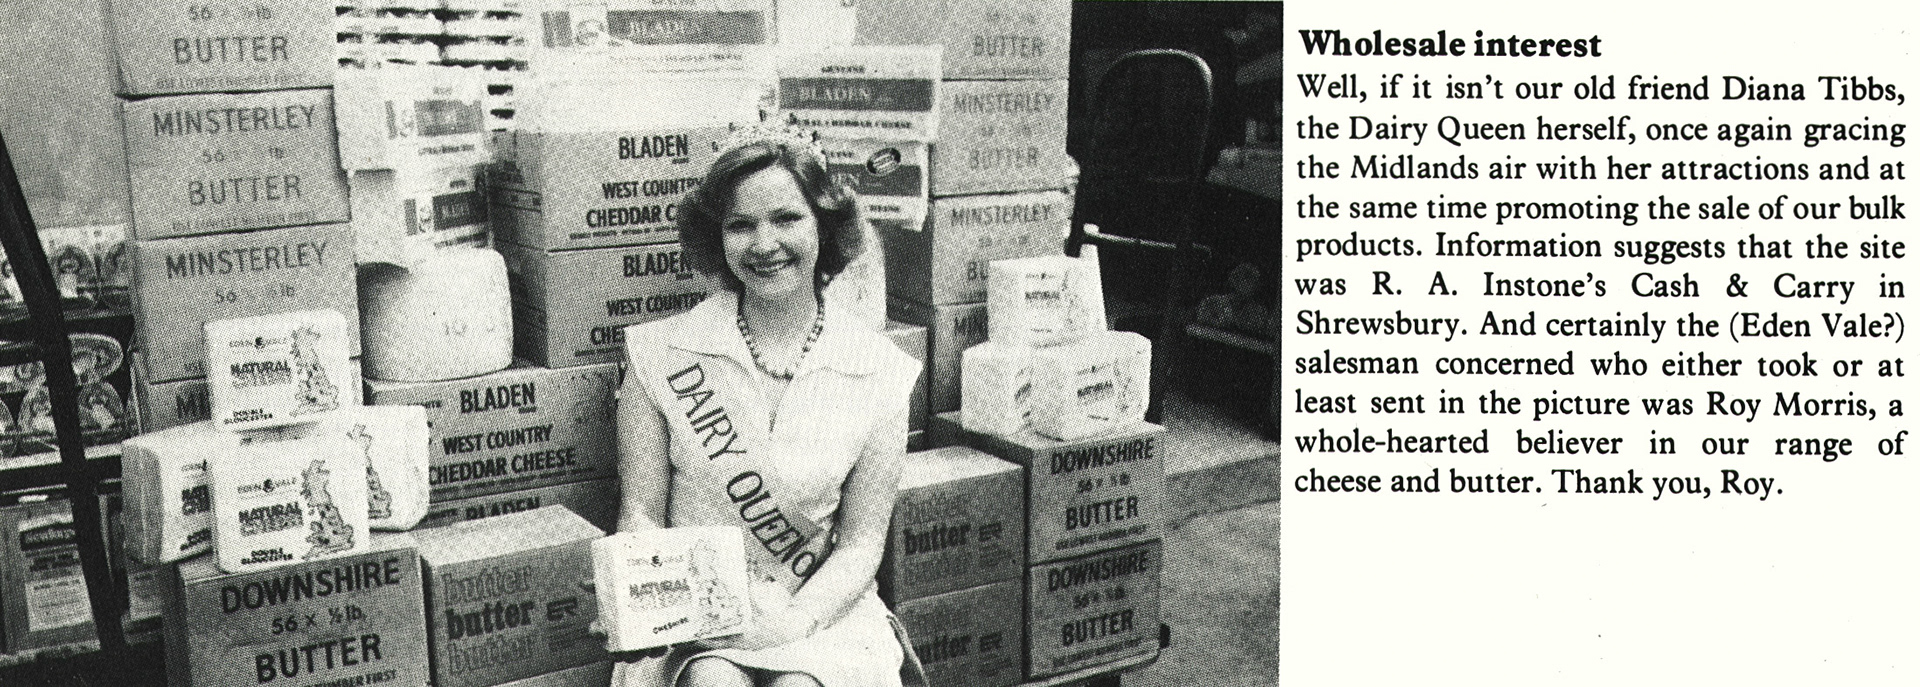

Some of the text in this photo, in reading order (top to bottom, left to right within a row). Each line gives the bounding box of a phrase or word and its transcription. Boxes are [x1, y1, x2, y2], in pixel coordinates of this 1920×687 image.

[174, 36, 289, 64] BUTTER
[973, 35, 1045, 58] BUTTER
[1299, 30, 1601, 57] Wholesale interest
[799, 87, 872, 102] BLADEN
[954, 92, 1054, 114] MINSTERLEY
[1297, 74, 1366, 103] Well,
[1381, 74, 1403, 98] if
[1413, 74, 1431, 98] it
[1516, 83, 1563, 99] our
[1574, 75, 1615, 100] old
[1628, 75, 1709, 100] friend
[1723, 76, 1805, 100] Diana
[1818, 76, 1904, 105] Tibbs,
[153, 105, 315, 136] MINSTERLEY
[1297, 115, 1906, 147] the Dairy Queen herself, once again gracing
[619, 134, 689, 160] BLADEN
[1297, 155, 1905, 180] the Midlands air with her attractions and at
[189, 175, 301, 206] BUTTER
[602, 181, 639, 200] WEST
[586, 204, 662, 228] CHEDDAR
[952, 203, 1051, 227] MINSTERLEY
[1297, 194, 1905, 226] the same time promoting the sale of our bulk
[166, 241, 327, 279] MINSTERLEY
[1297, 232, 1905, 264] products. Information suggests that the site
[1295, 278, 1346, 295] was
[1373, 272, 1401, 295] R.
[1429, 271, 1457, 295] A.
[1632, 273, 1699, 297] Cash
[1727, 274, 1748, 297] &
[1774, 273, 1854, 304] Carry
[1880, 273, 1904, 297] in
[606, 297, 643, 317] WEST
[1297, 310, 1904, 343] Shrewsbury. And certainly the (Eden Vale?)
[231, 359, 291, 375] NATURAL
[1296, 349, 1904, 377] salesman concerned who either took or at
[460, 382, 536, 414] BLADEN
[666, 363, 747, 460] DAIRY
[1296, 389, 1903, 422] least sent in the picture was Roy Morris, a
[443, 424, 554, 455] WEST COUNTRY
[1295, 428, 1908, 462] whole-hearted believer in our range of
[511, 448, 577, 475] CHEESE
[1051, 437, 1154, 475] DOWNSHIRE
[1295, 468, 1782, 501] cheese and butter. Thank you, Roy.
[238, 501, 302, 525] NATURAL
[1066, 496, 1138, 531] BUTTER
[903, 523, 971, 556] butter
[221, 557, 400, 614] DOWNSHIRE
[1049, 551, 1148, 592] DOWNSHIRE
[272, 615, 298, 635] 56
[446, 600, 535, 640] butter
[1062, 609, 1134, 647] BUTTER
[255, 633, 382, 684] BUTTER
[914, 634, 971, 665] utter
